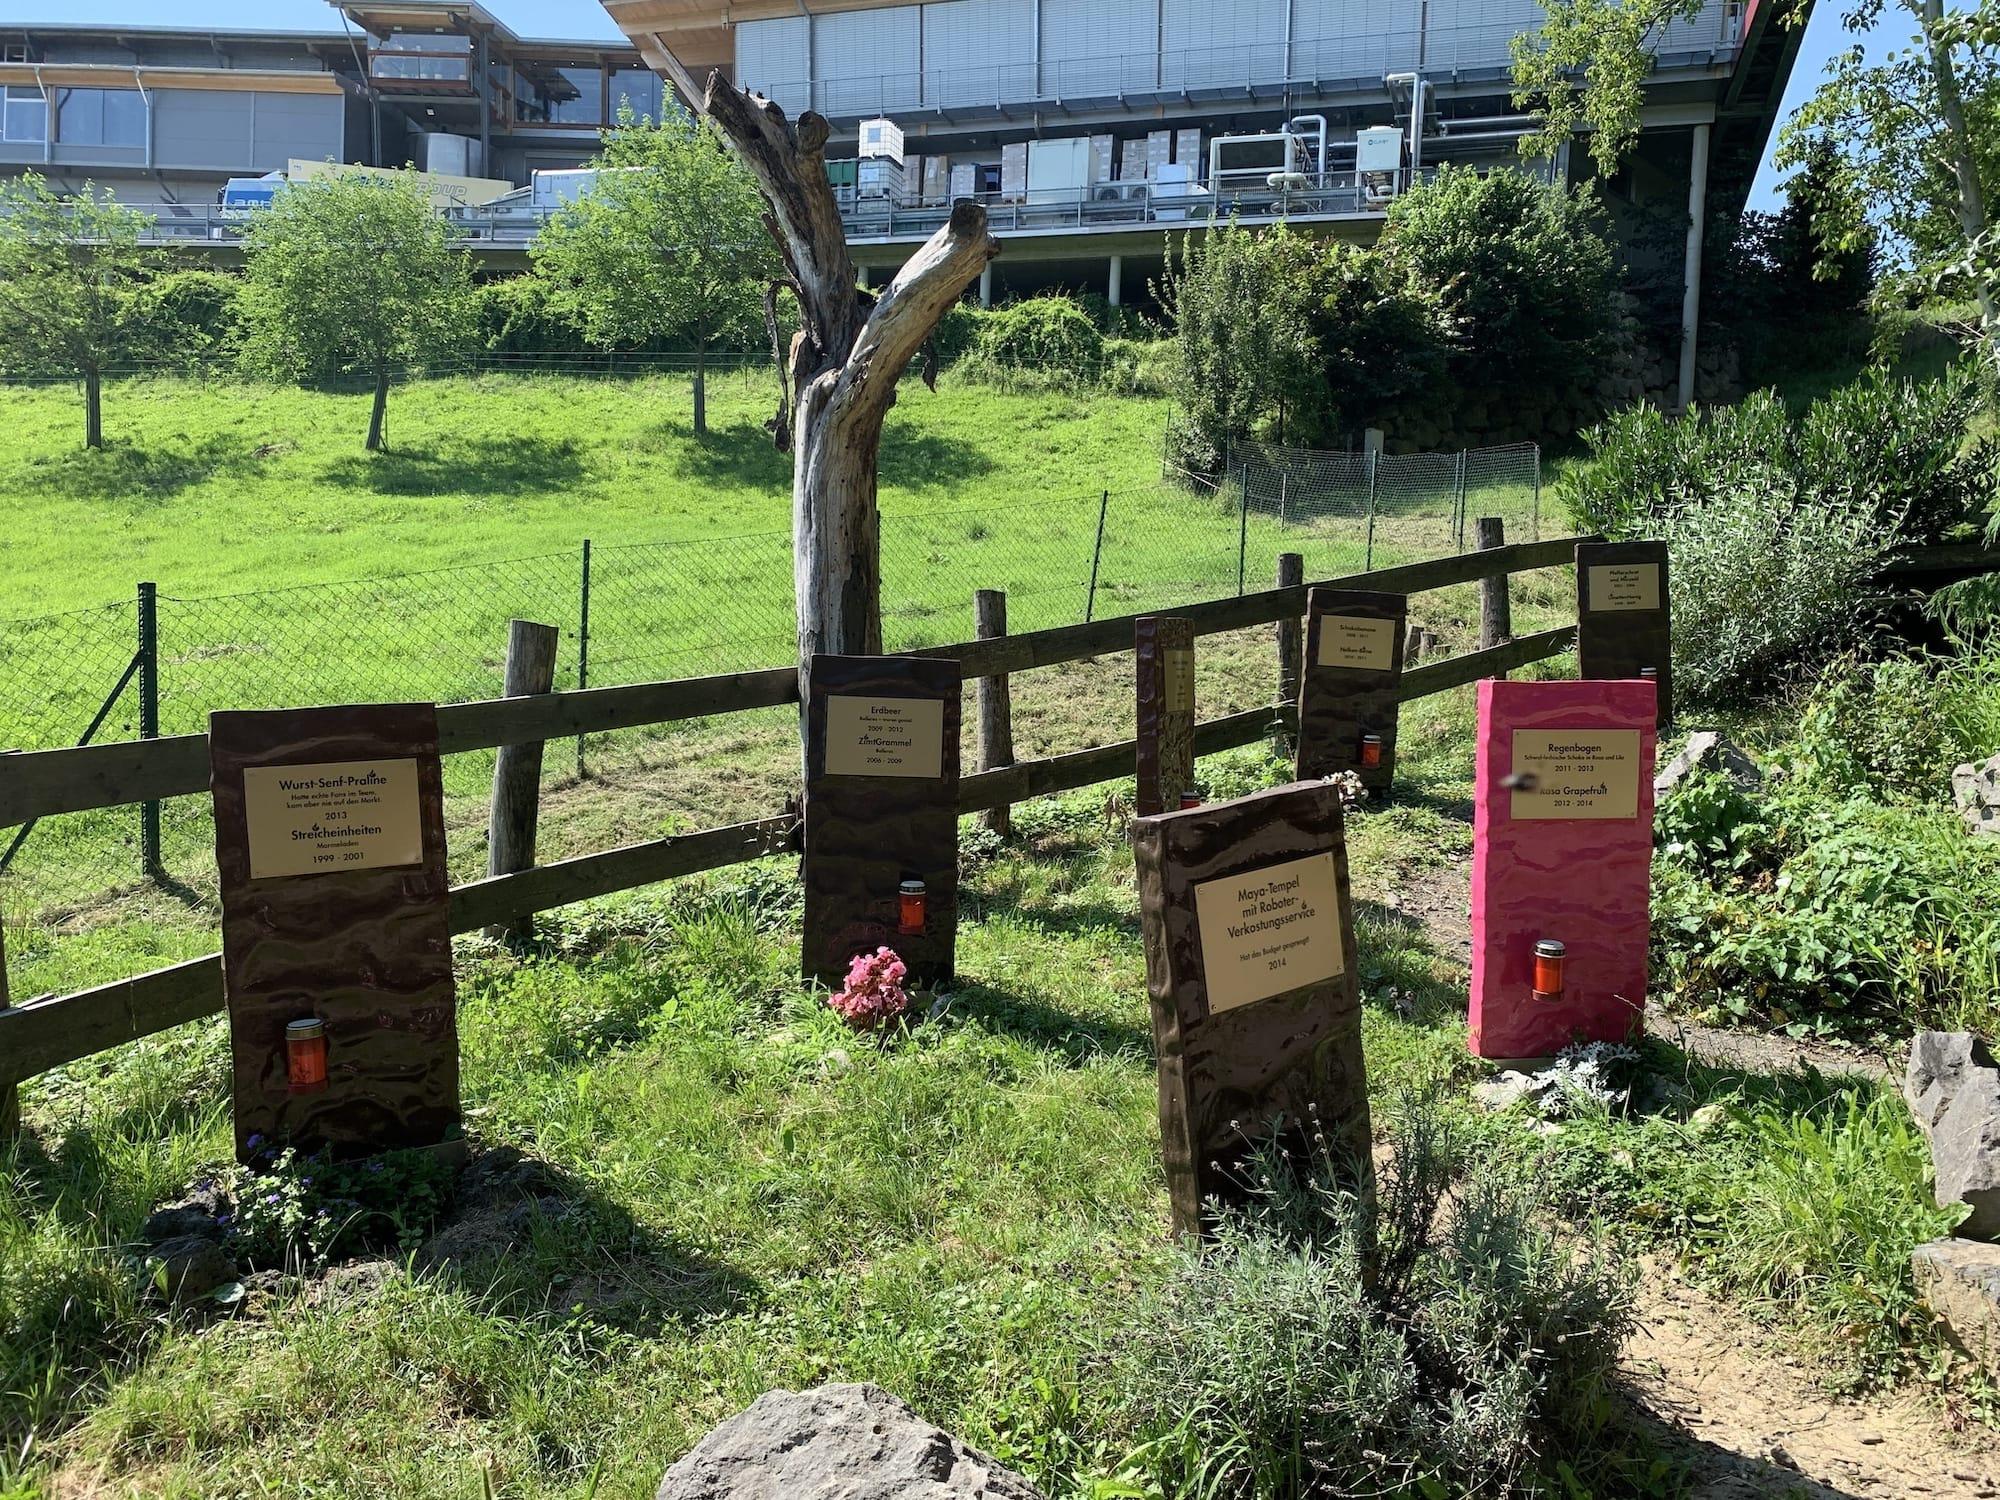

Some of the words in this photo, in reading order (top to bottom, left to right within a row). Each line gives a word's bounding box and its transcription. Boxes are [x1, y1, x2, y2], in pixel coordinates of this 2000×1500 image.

[871, 706, 902, 715] Erdbeer
[858, 736, 912, 747] ZimtGrammel
[1548, 743, 1602, 754] Regenbogen
[279, 773, 387, 791] Wurst-Senf-Praline
[1563, 785, 1607, 797] Grapefruit
[291, 793, 309, 801] Hatte
[304, 800, 320, 808] aber
[333, 798, 345, 806] auf
[325, 811, 347, 820] 2013
[291, 824, 382, 841] Streicheinheiten
[316, 840, 359, 849] Marmeladen
[313, 854, 335, 863] 1999
[343, 852, 364, 861] 2001
[1238, 874, 1300, 902] Maya-Tempel
[1242, 904, 1257, 918] mit
[1260, 897, 1299, 913] Roboter-
[1227, 907, 1316, 939] Verkostungsservice
[1262, 944, 1281, 955] Budget
[1268, 957, 1287, 970] 2014
